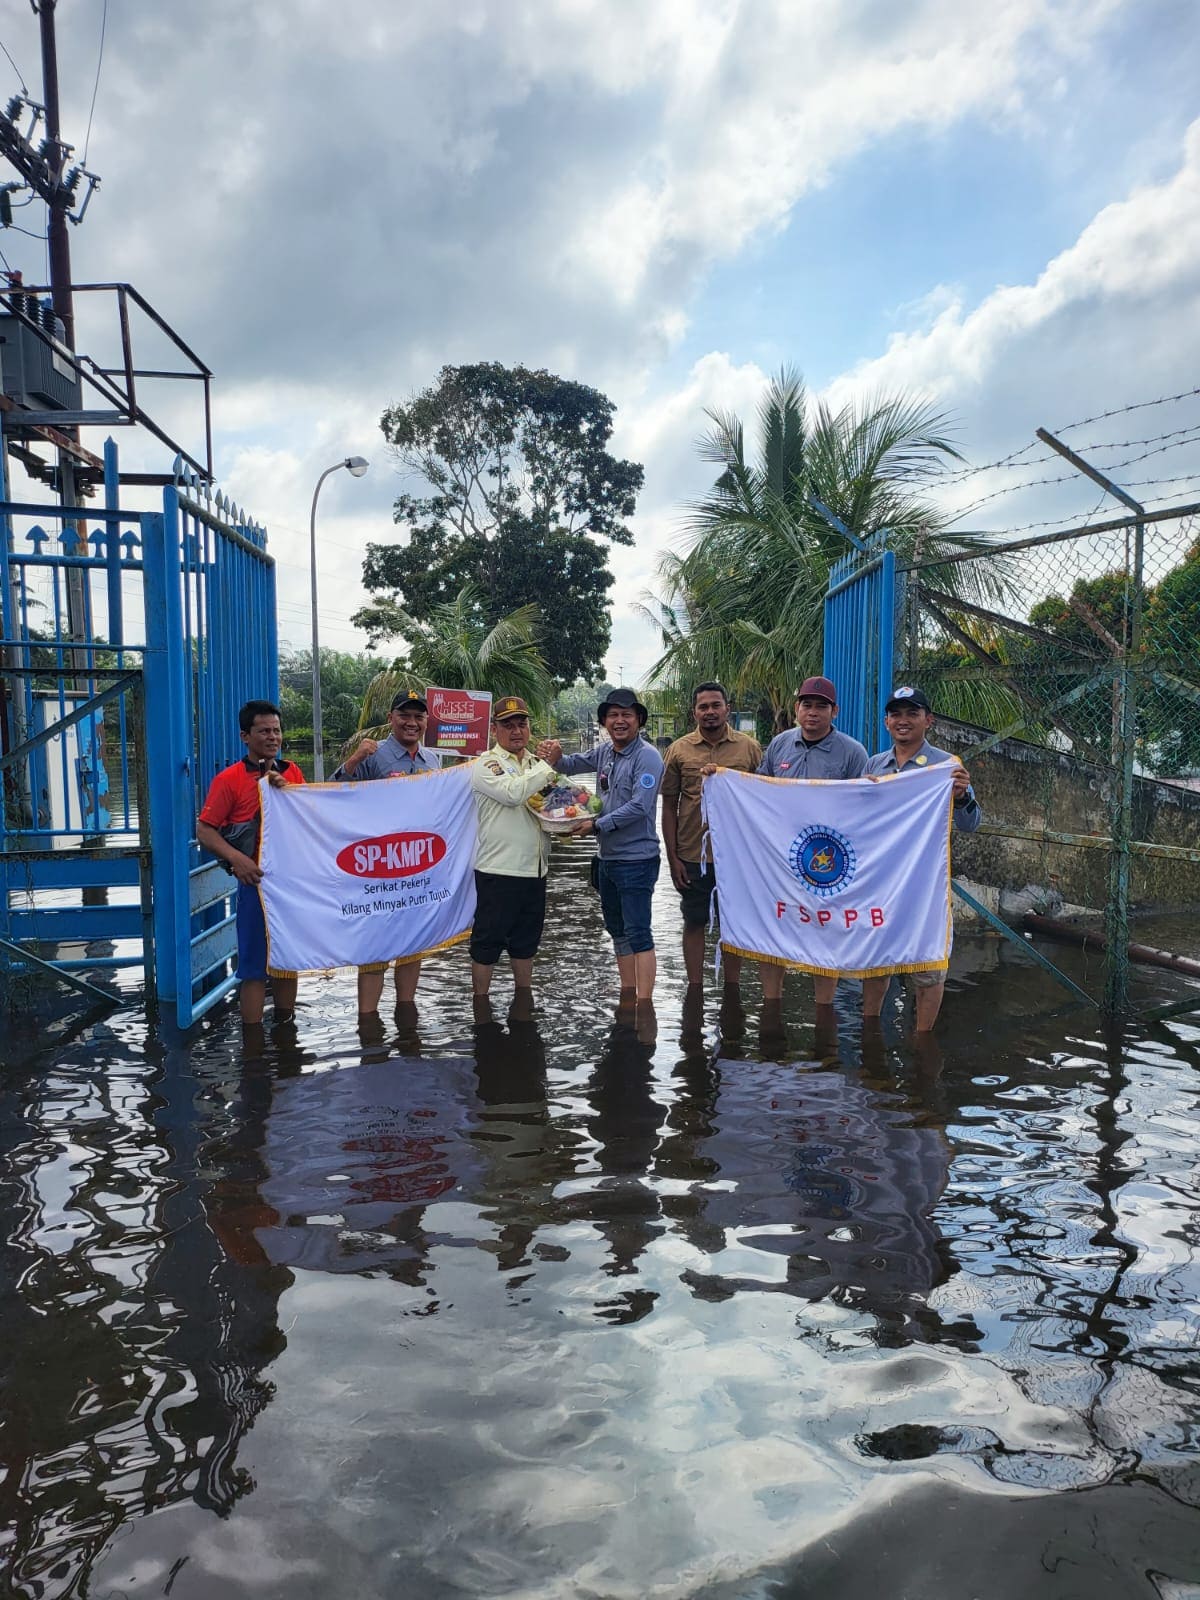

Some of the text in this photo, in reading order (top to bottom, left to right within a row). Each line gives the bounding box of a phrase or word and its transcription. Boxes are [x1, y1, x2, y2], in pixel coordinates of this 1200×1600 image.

[441, 702, 475, 713] HSSE
[353, 837, 435, 873] SP-KMPT
[364, 876, 431, 894] Serikat Pekerja
[341, 888, 451, 916] Kilang Minyak Putri Tujuh
